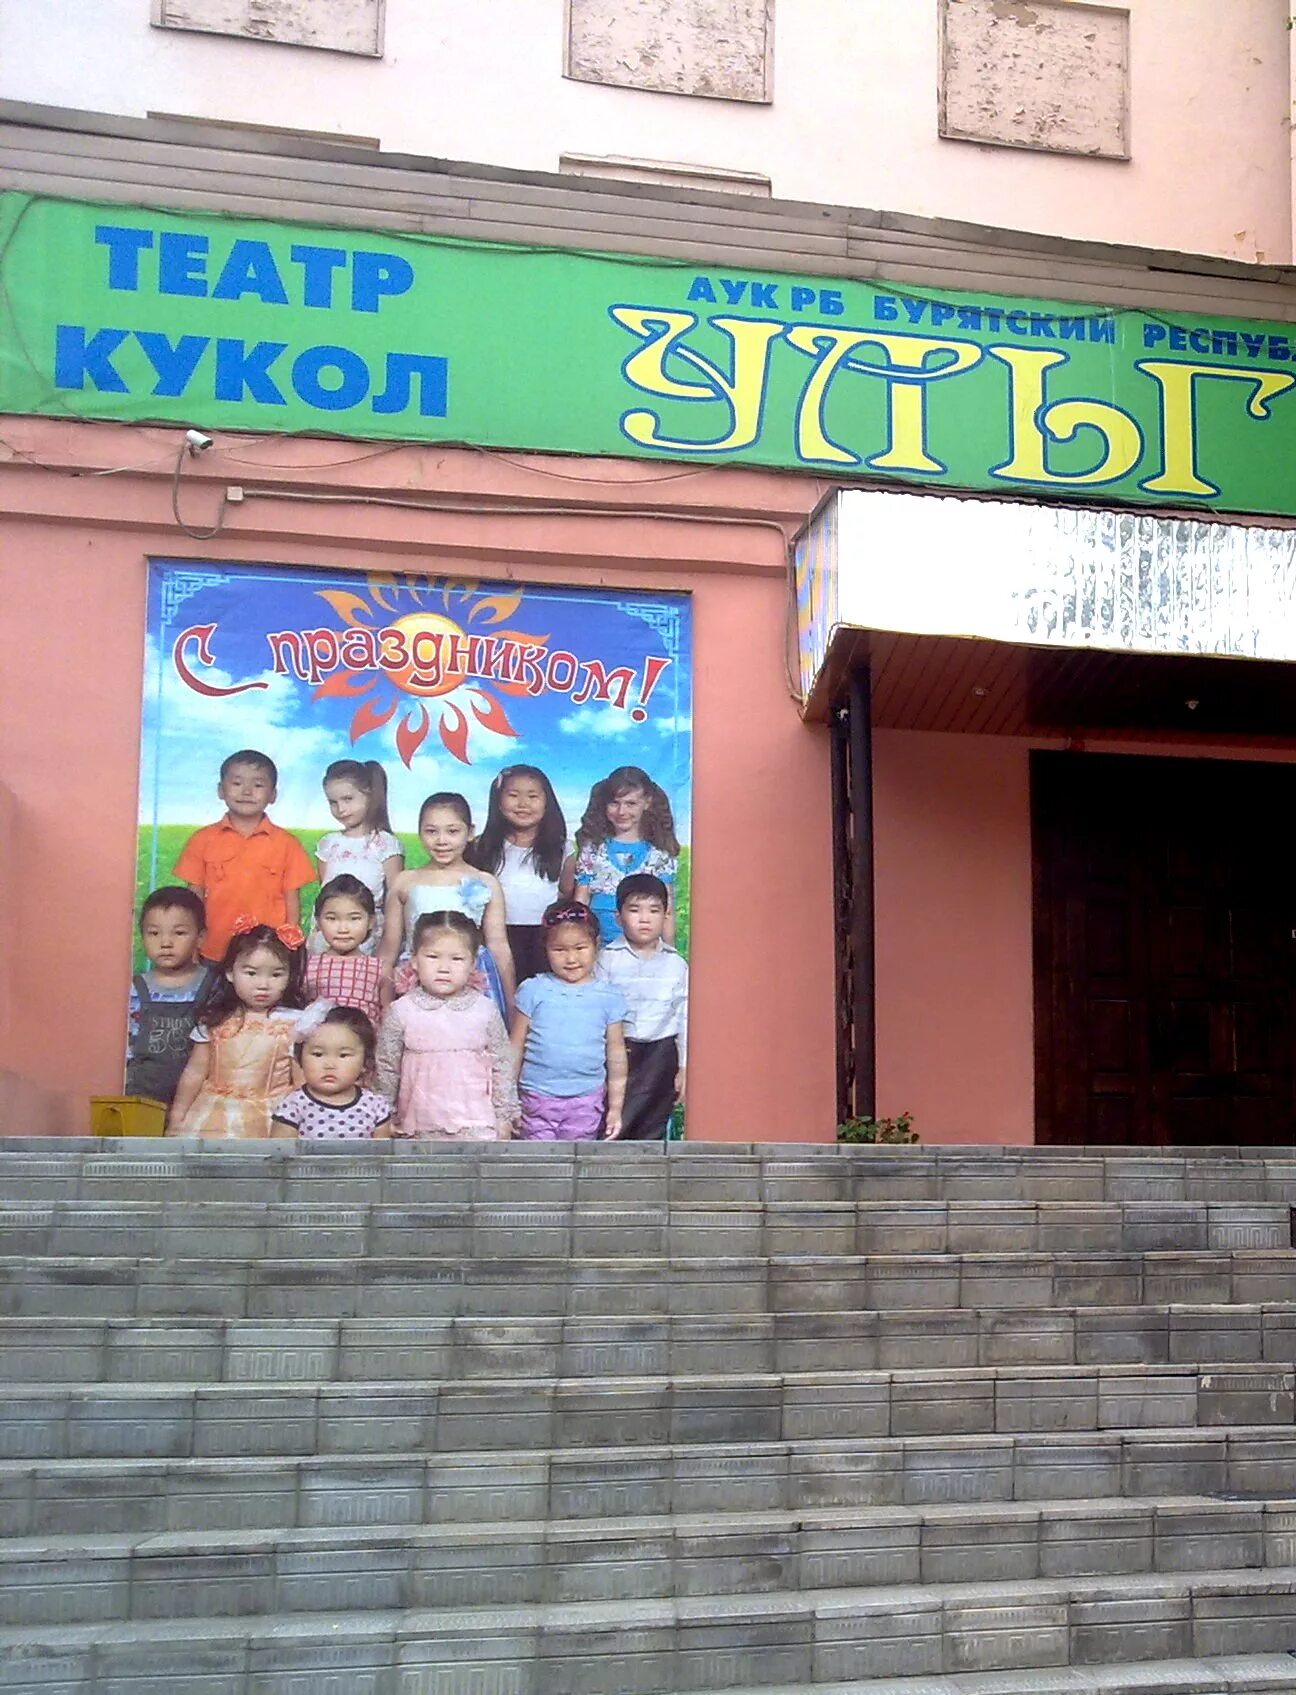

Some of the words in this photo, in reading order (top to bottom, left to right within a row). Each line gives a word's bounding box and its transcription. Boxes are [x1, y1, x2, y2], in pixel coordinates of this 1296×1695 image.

[94, 225, 415, 313] ТЕАТР
[687, 276, 780, 309] АУК
[791, 286, 844, 316] РБ
[874, 295, 1117, 344] БУРЯТСКИЙ
[54, 325, 448, 419] КУКОЛ
[173, 622, 269, 697] С
[267, 627, 672, 722] праздником!
